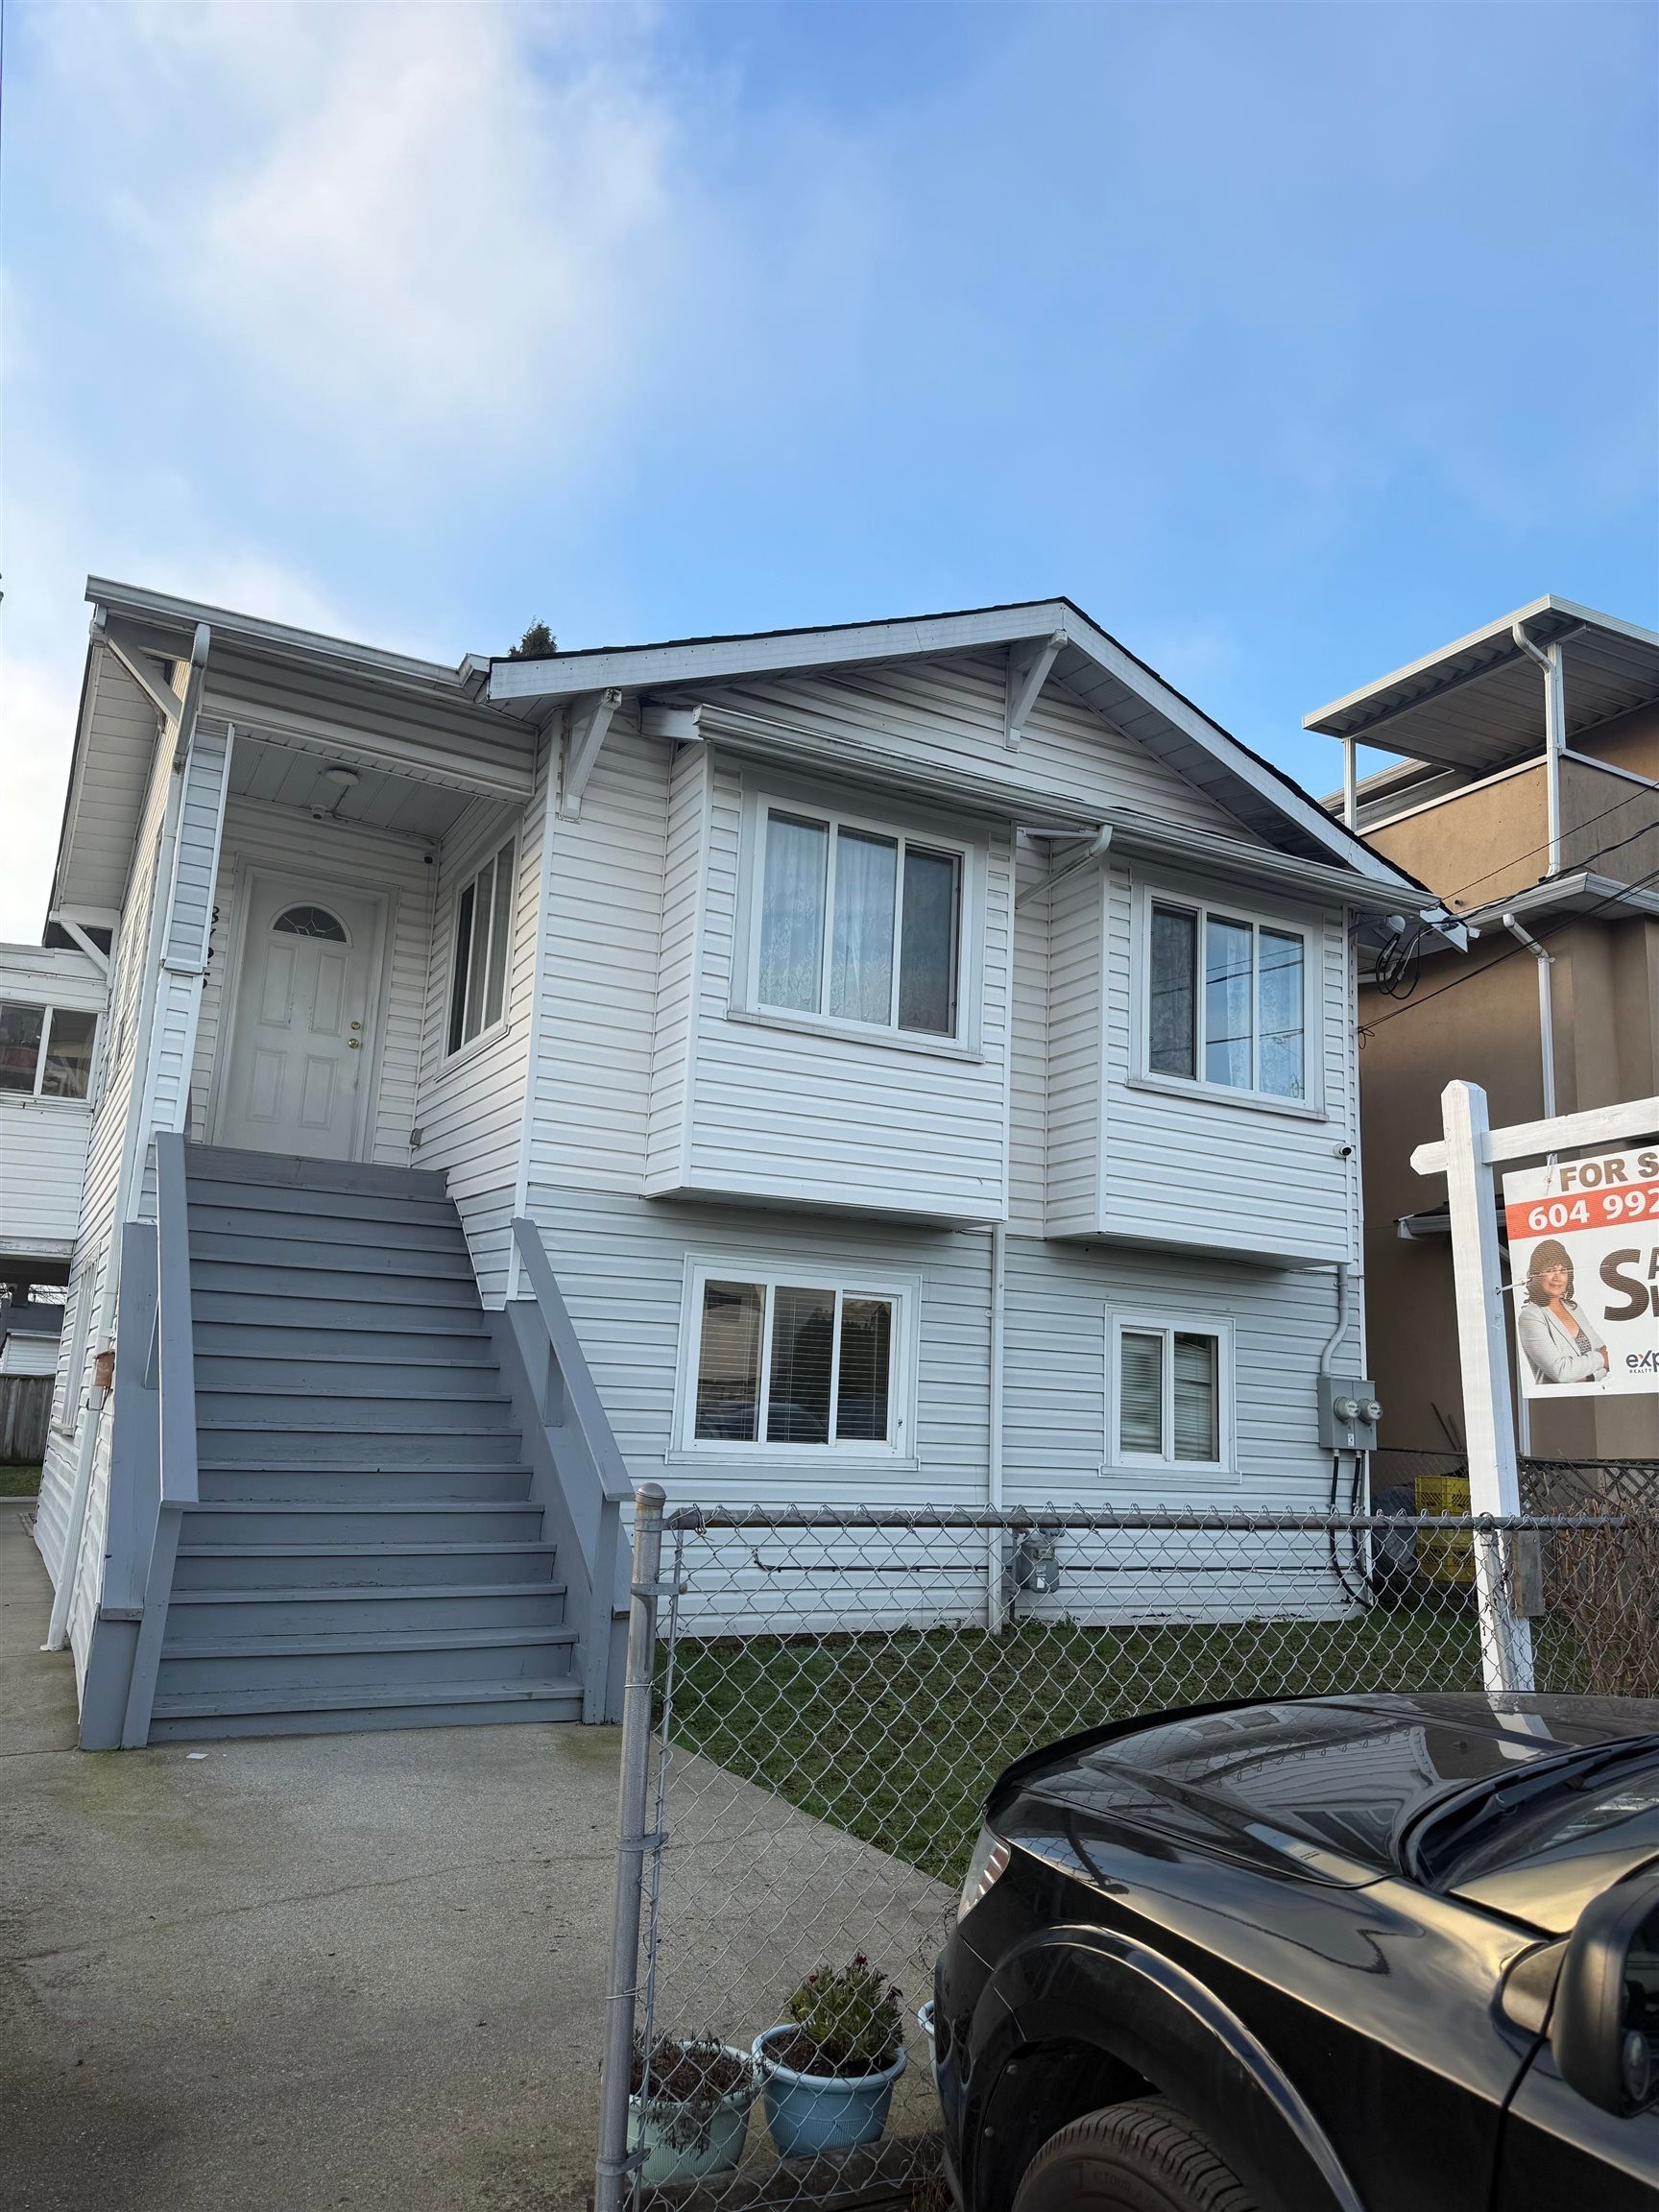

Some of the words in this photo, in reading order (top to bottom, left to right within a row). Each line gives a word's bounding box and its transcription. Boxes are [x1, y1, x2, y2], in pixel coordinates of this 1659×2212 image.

[1559, 1158, 1628, 1192] FOR
[1527, 1199, 1590, 1230] 604
[1602, 1187, 1659, 1220] 992
